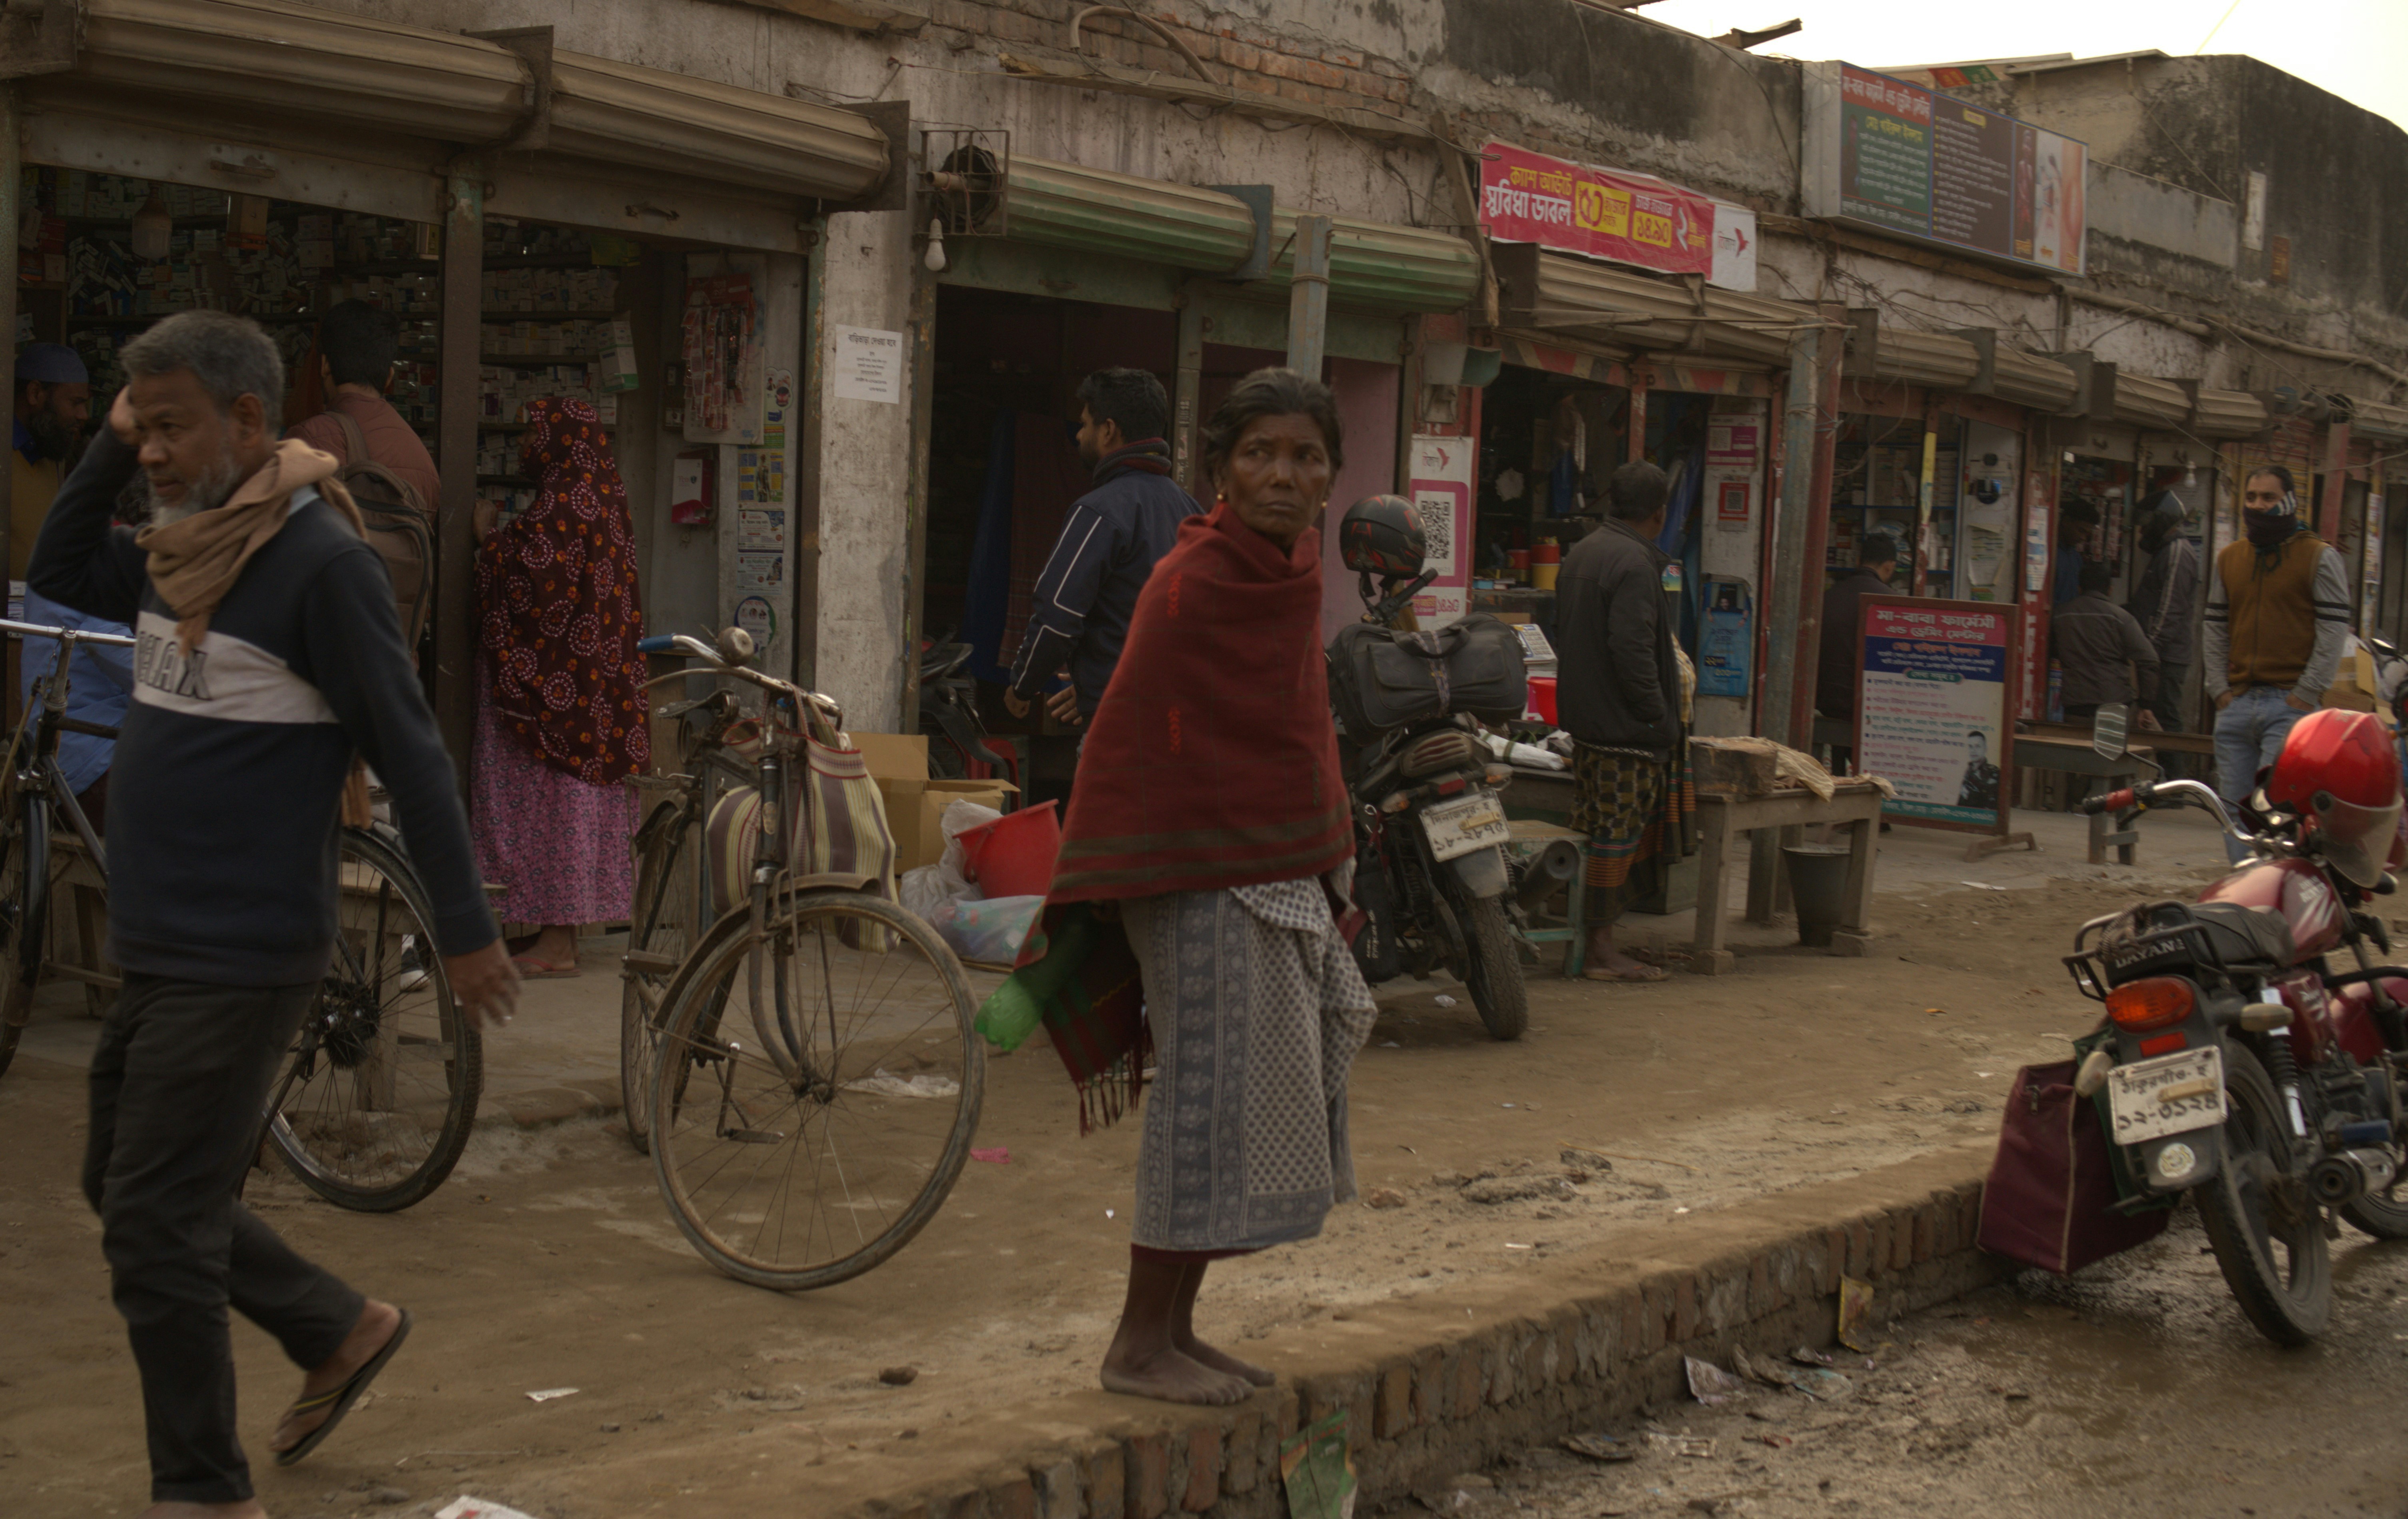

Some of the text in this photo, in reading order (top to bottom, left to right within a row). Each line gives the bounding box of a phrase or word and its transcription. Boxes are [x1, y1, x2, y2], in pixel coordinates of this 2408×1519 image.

[1510, 165, 1573, 196] ক্যাশ আউটে
[1485, 179, 1572, 226] সুবিধা ডাবল
[1876, 610, 1996, 629] মা-বাবা ফার্মেসী
[1946, 630, 1986, 641] সেন্টার
